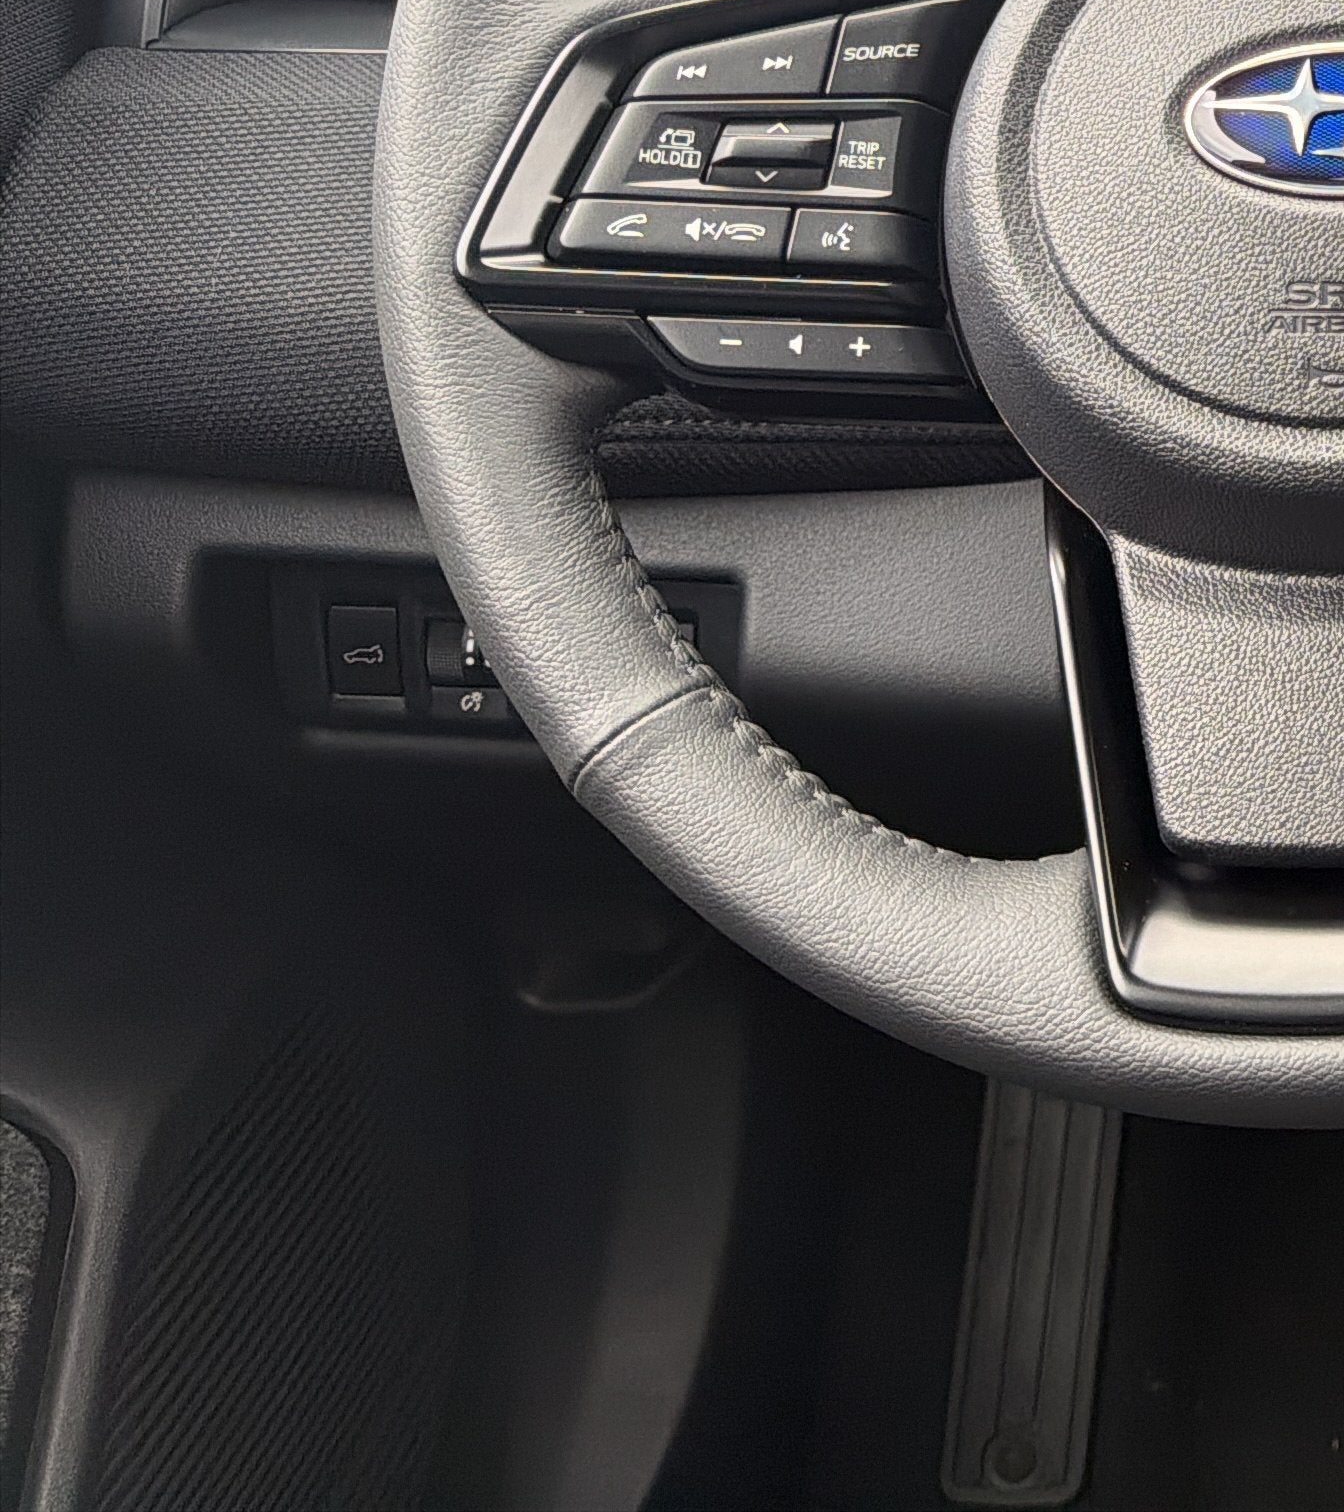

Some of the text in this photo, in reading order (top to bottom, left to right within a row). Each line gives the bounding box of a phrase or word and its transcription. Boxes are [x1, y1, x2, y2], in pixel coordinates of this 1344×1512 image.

[842, 43, 920, 62] SOURCE
[849, 140, 880, 155] TRIP
[837, 155, 886, 171] RESET
